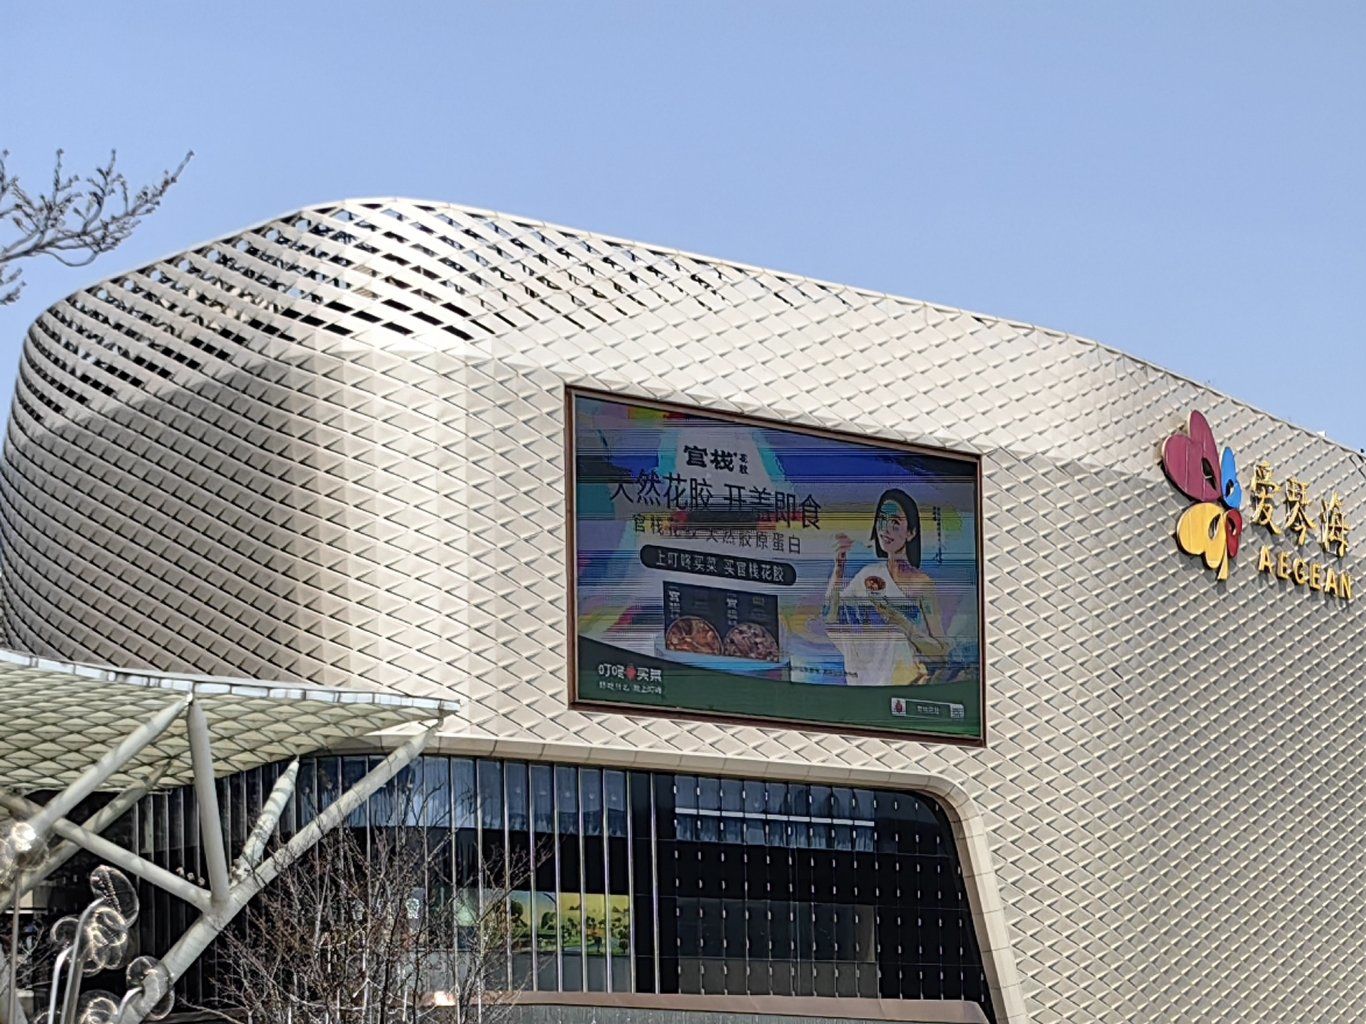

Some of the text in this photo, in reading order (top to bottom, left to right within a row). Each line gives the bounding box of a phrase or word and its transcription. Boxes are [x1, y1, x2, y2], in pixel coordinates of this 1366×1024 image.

[683, 445, 735, 472] 官栈
[610, 469, 714, 511] 天然花胶
[1250, 461, 1352, 557] 爱琴海
[656, 550, 784, 583] 上叮咚买菜 买官栈花胶
[1258, 545, 1352, 600] AEGEAN
